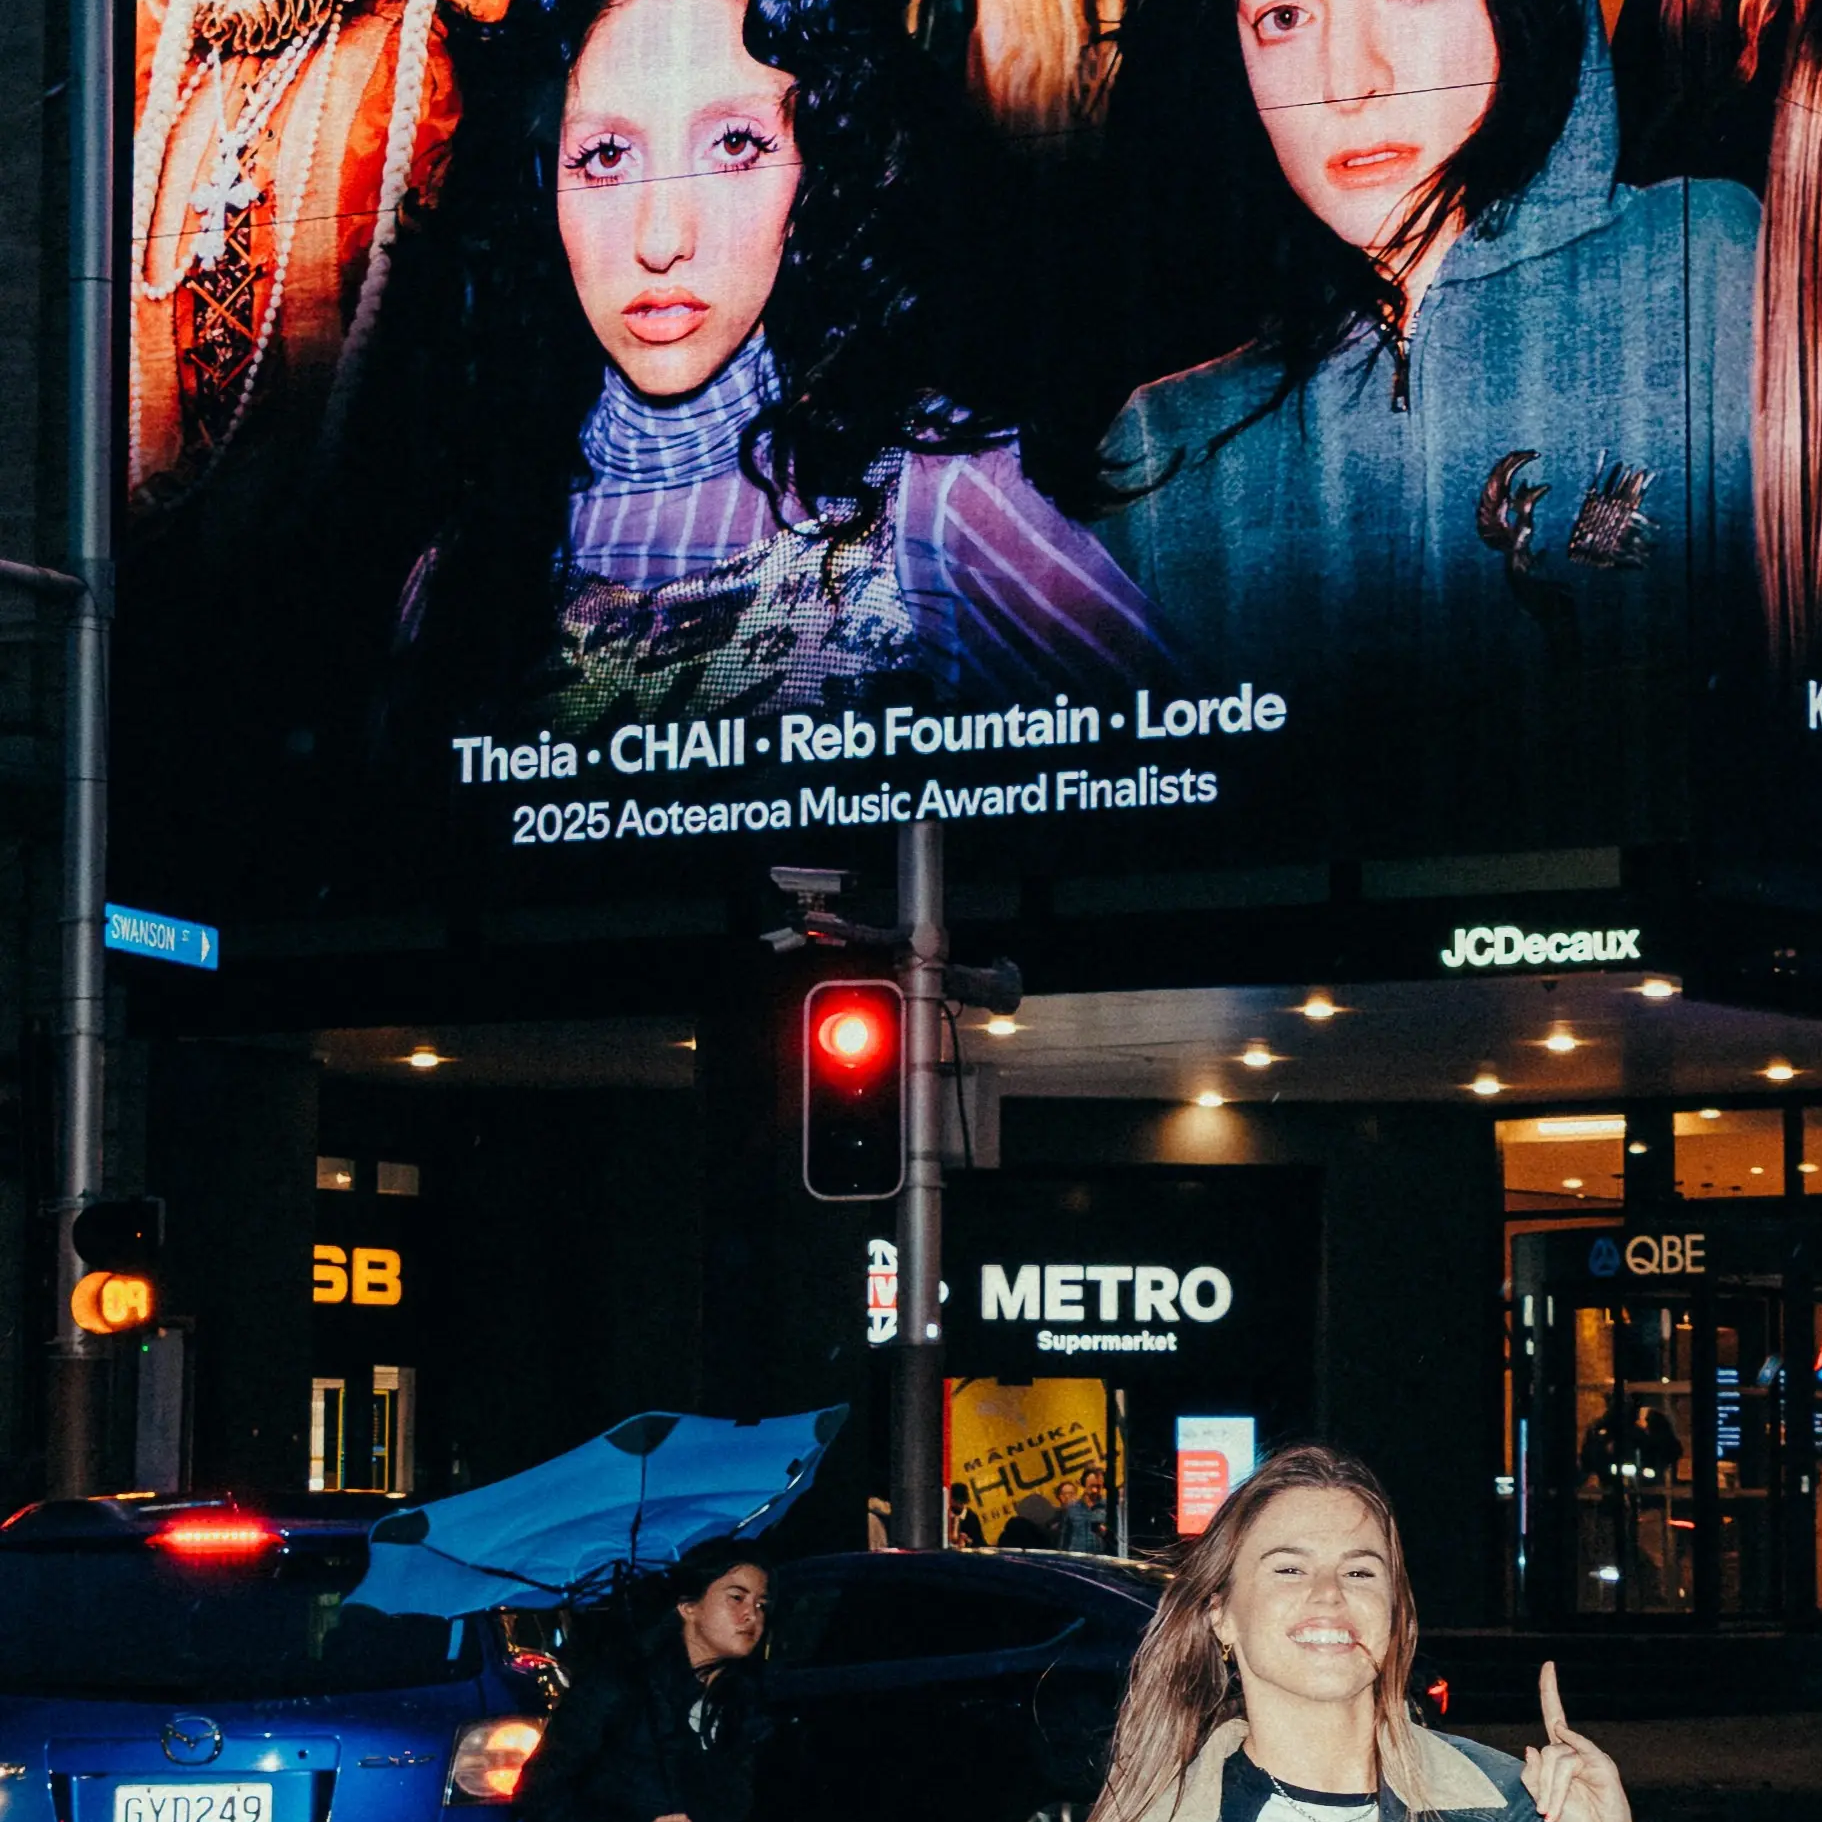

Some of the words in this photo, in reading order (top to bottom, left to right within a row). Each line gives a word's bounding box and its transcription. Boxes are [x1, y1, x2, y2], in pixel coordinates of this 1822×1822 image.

[452, 729, 578, 784] Theia
[779, 710, 877, 764] Reb
[884, 693, 1100, 756] Fountain
[1135, 682, 1288, 740] Lorde
[512, 800, 610, 845] 2025
[614, 798, 791, 840] Aotearoa
[800, 782, 912, 827] Music
[915, 773, 1048, 821] Award
[1055, 764, 1218, 811] Finalists
[110, 913, 176, 952] SWANSON
[1441, 925, 1641, 968] JCDecaux
[312, 1244, 402, 1305] SB
[1625, 1233, 1706, 1276] QBE
[981, 1264, 1234, 1323] METRO
[1037, 1330, 1178, 1356] Supermarket
